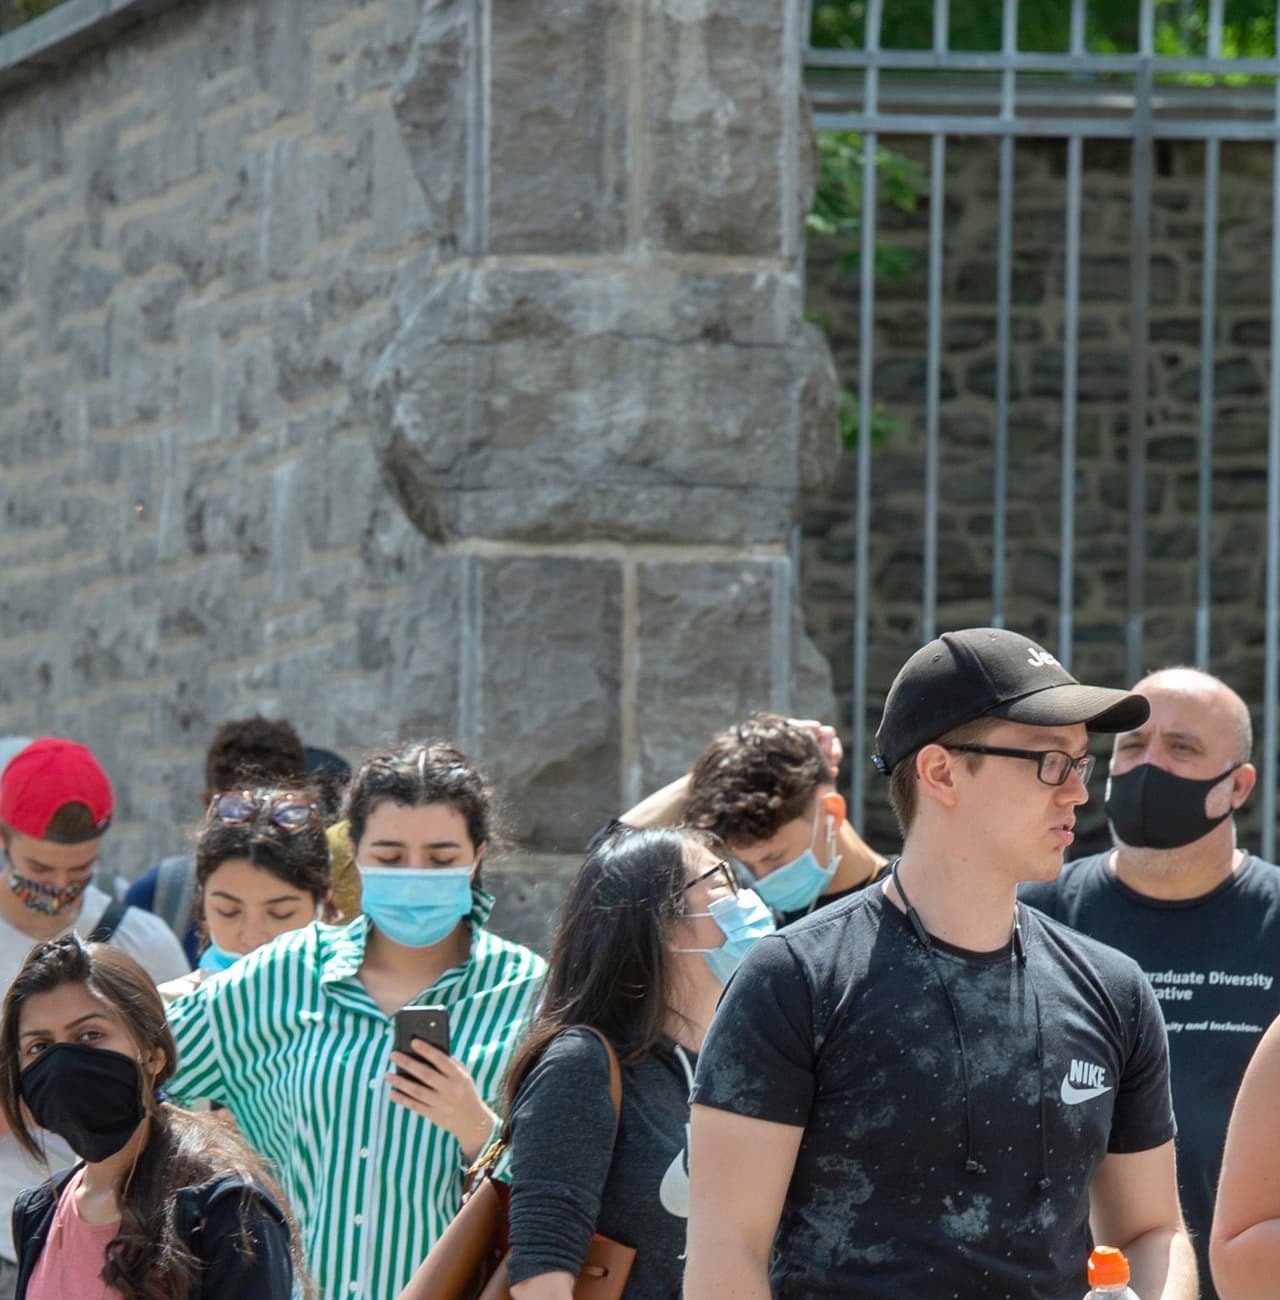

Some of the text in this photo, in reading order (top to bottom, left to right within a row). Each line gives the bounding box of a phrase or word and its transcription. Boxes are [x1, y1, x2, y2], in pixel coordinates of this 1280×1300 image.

[1209, 971, 1273, 990] Diversity
[1154, 987, 1193, 1000] ative
[1185, 1020, 1209, 1031] and
[1070, 1059, 1106, 1089] NIKE
